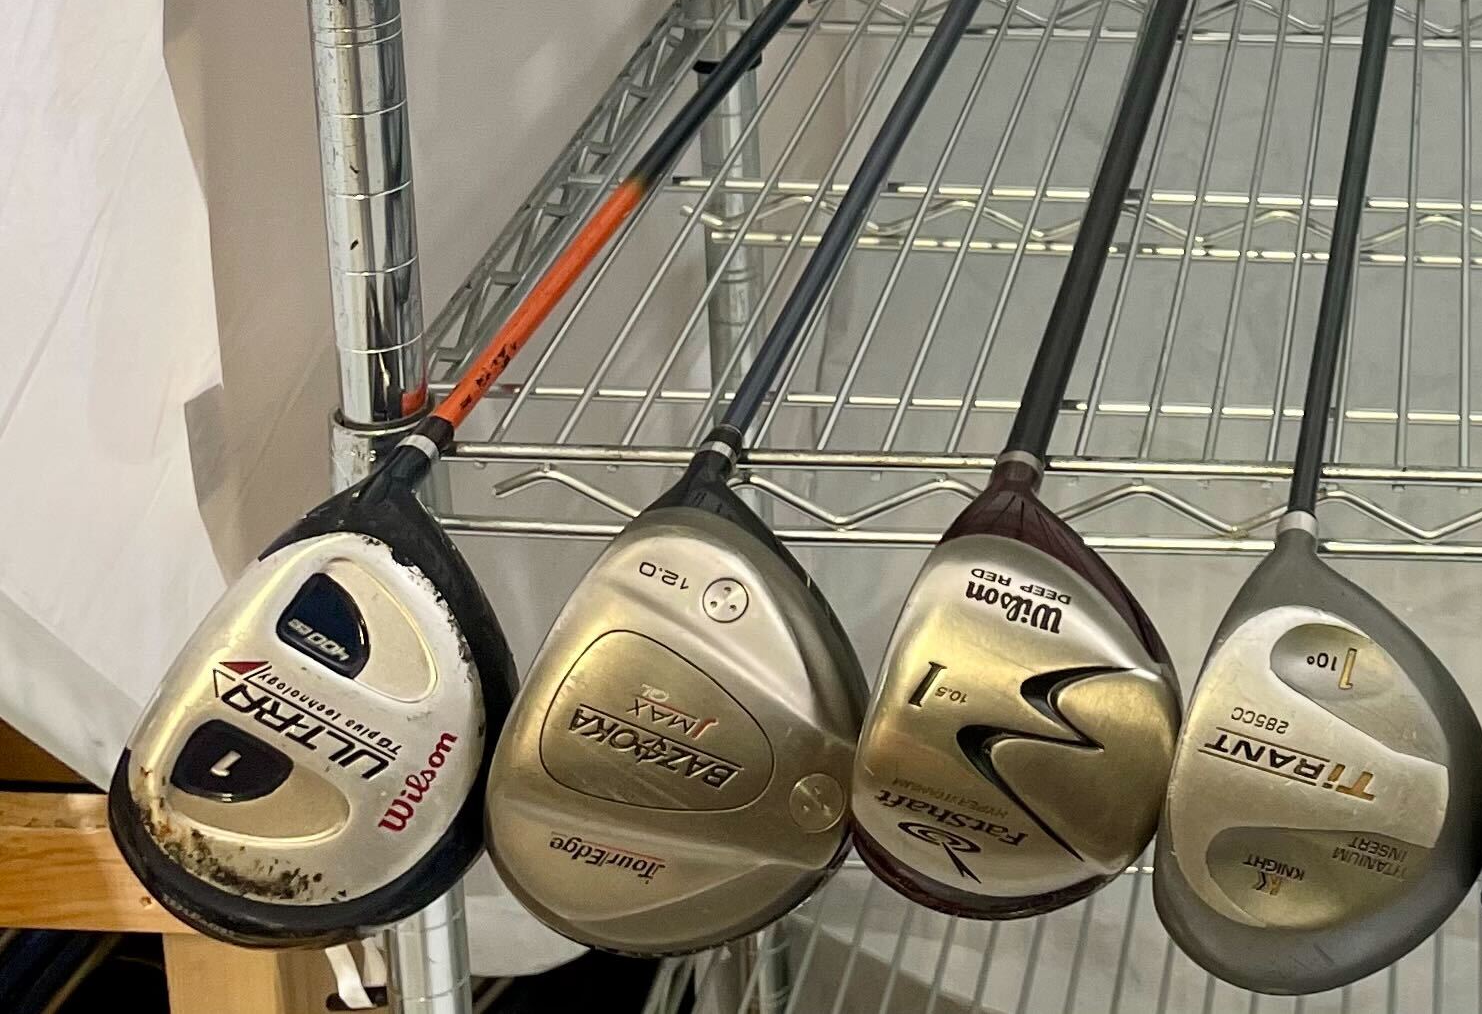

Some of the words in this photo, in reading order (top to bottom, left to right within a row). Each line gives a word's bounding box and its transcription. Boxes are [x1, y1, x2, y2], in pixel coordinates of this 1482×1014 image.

[638, 560, 690, 592] 12.0
[970, 568, 1012, 587] RED
[965, 580, 1064, 635] Wilson
[1019, 584, 1071, 606] DEEP
[1337, 647, 1358, 691] 1
[935, 686, 969, 704] 10.5
[221, 683, 390, 780] ULTRA
[377, 730, 460, 833] Wilson
[875, 788, 1028, 847] FatShaft
[1331, 845, 1406, 881] TITANIUM
[1348, 836, 1408, 861] INSERT
[1243, 855, 1306, 881] KNIGHT
